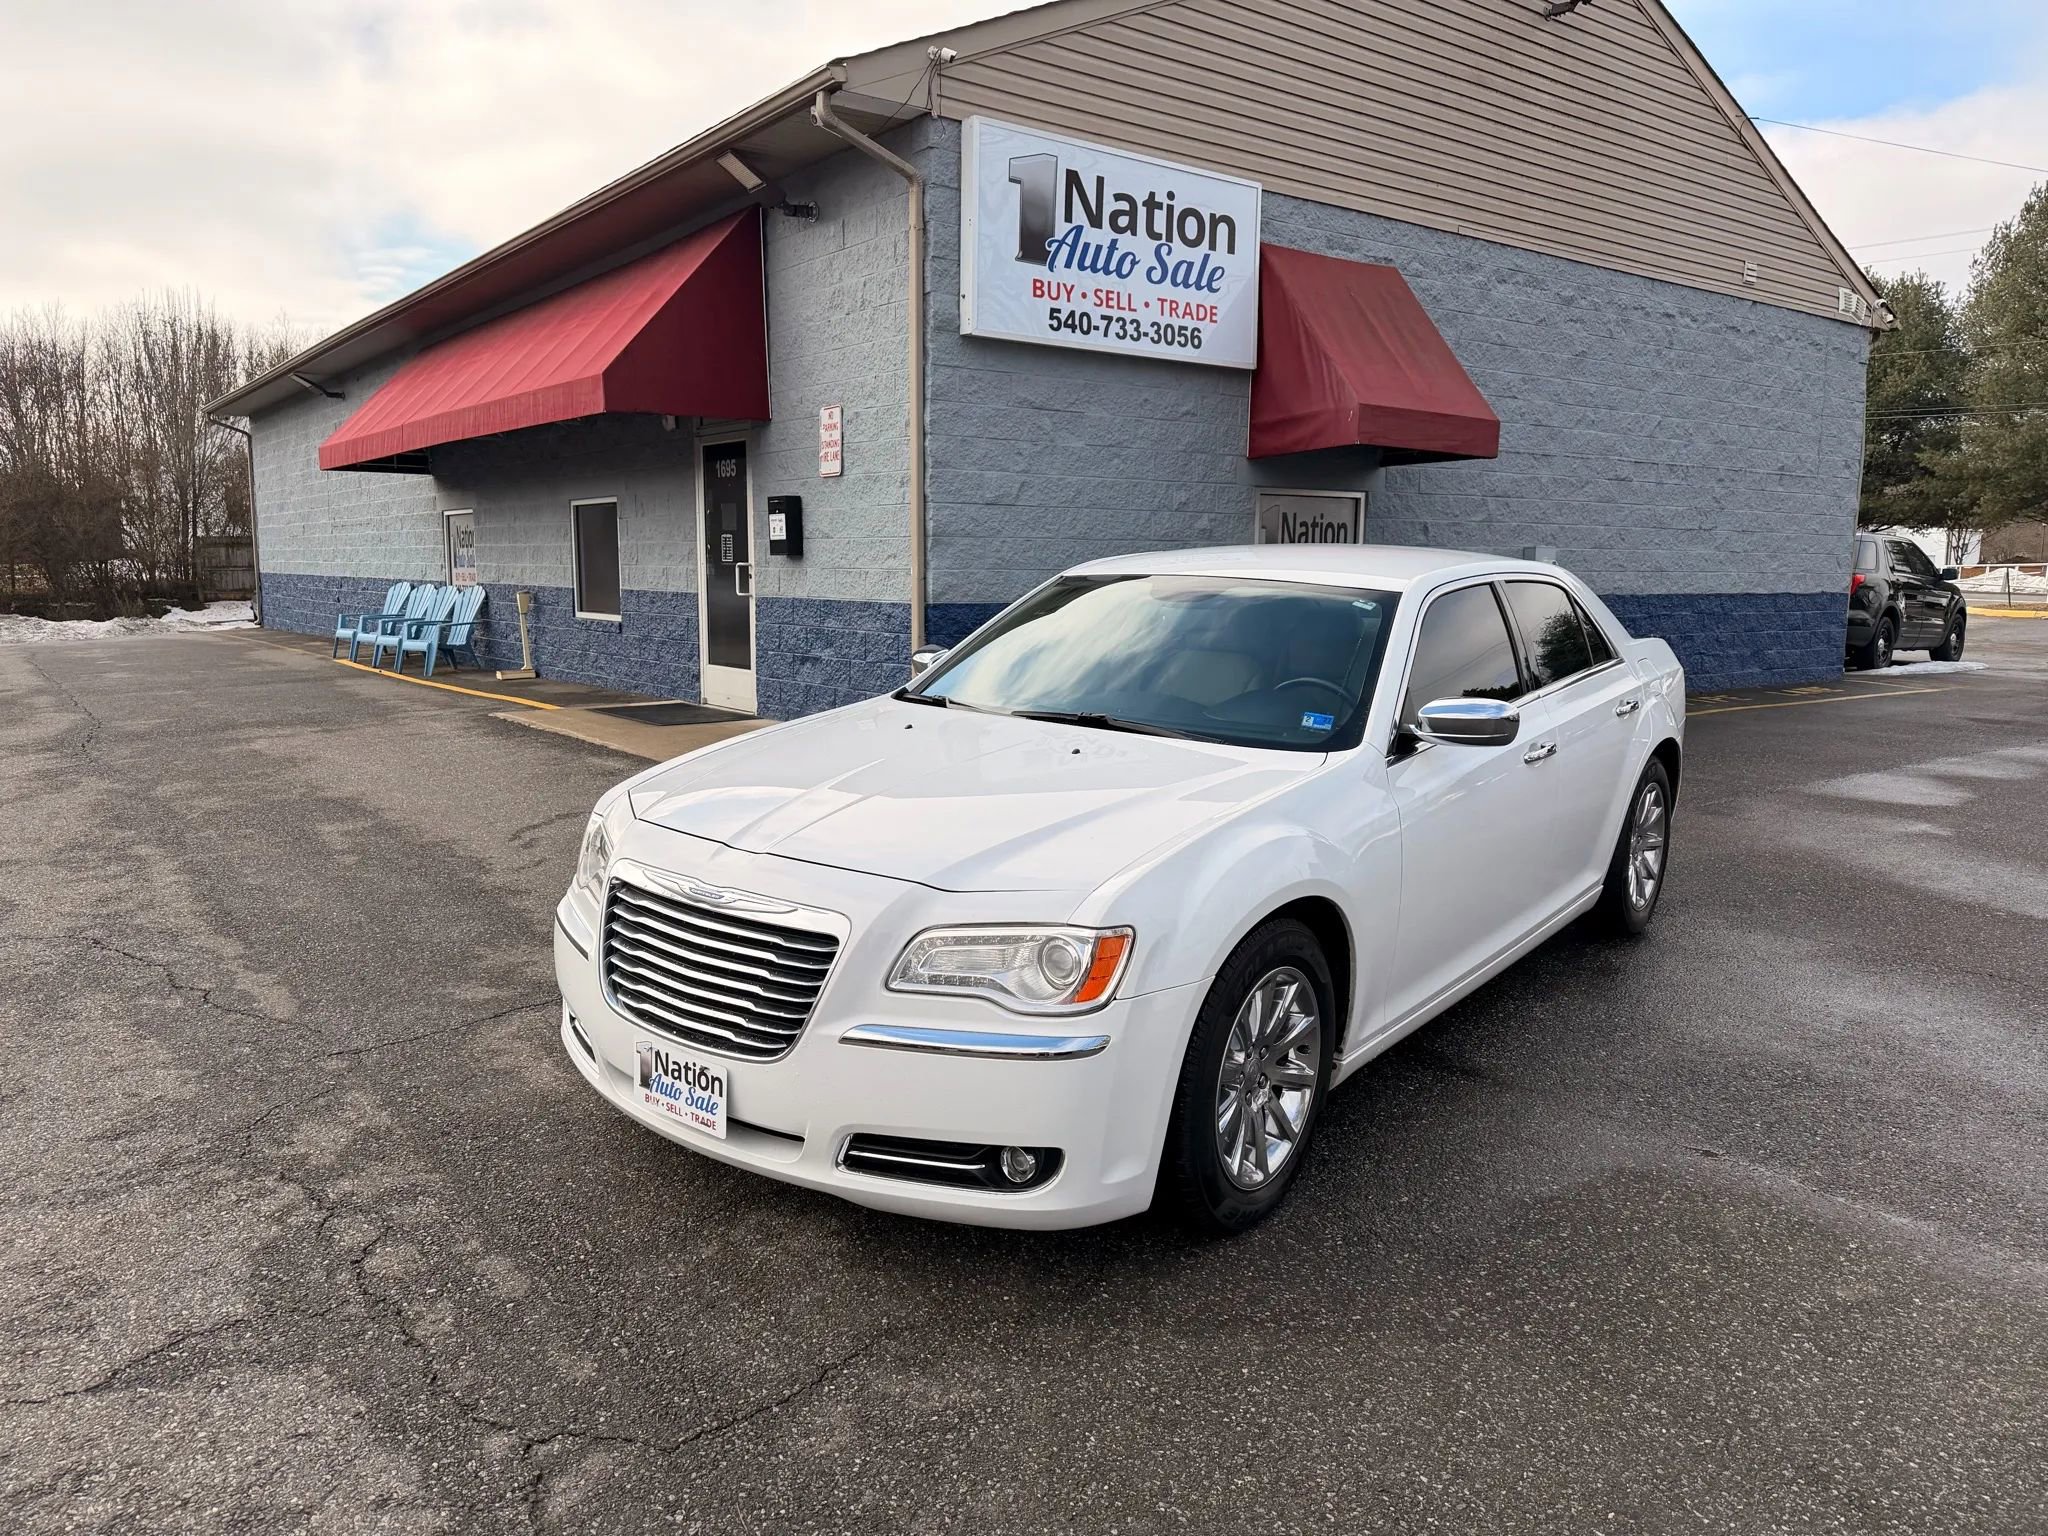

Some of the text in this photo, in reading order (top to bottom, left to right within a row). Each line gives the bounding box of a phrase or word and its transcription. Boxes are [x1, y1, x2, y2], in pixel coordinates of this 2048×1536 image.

[1008, 152, 1237, 267] 1 Nation
[1045, 223, 1226, 293] Auto Sale
[1031, 278, 1218, 324] BUY SELL TRADE
[1048, 307, 1203, 350] 540-733-3056
[715, 458, 737, 478] 1695
[1281, 512, 1348, 544] Nation
[636, 1040, 723, 1098] 1 Nation
[644, 1093, 717, 1131] BUY SELL TRADE
[649, 1073, 719, 1116] Auto Sale
